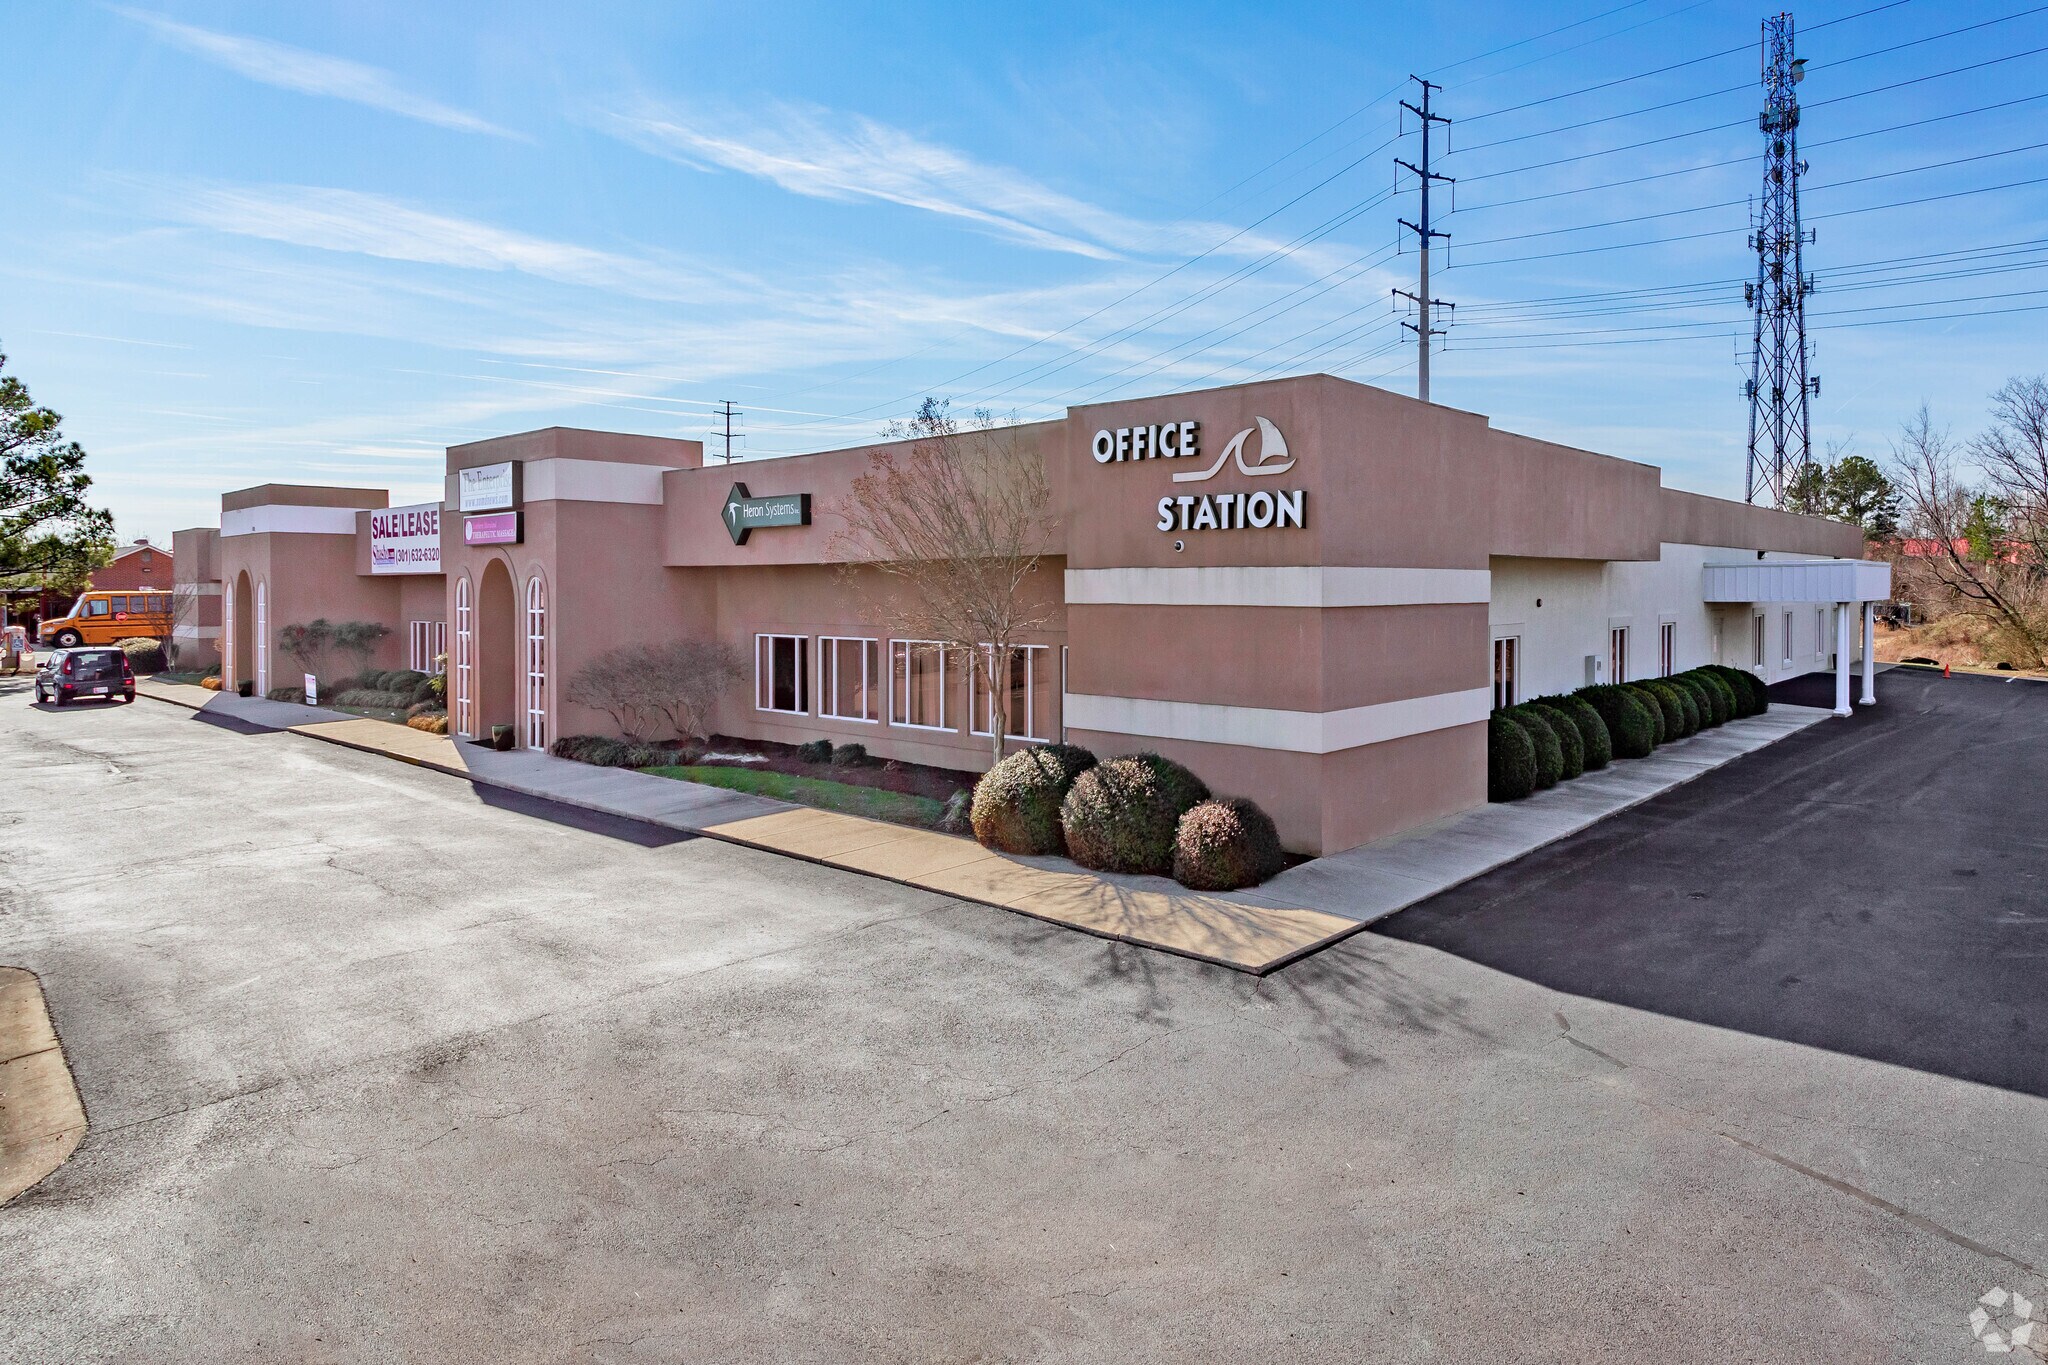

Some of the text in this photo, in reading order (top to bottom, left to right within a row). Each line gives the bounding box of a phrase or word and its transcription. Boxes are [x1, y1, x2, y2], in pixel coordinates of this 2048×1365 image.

[1092, 421, 1199, 463] OFFICE
[462, 472, 475, 492] The
[743, 504, 764, 518] Heron
[765, 502, 794, 519] Systems
[1157, 490, 1306, 531] STATION
[372, 510, 438, 539] SALE/LEASE
[396, 549, 410, 565] (301)
[411, 547, 439, 562] 632-6320
